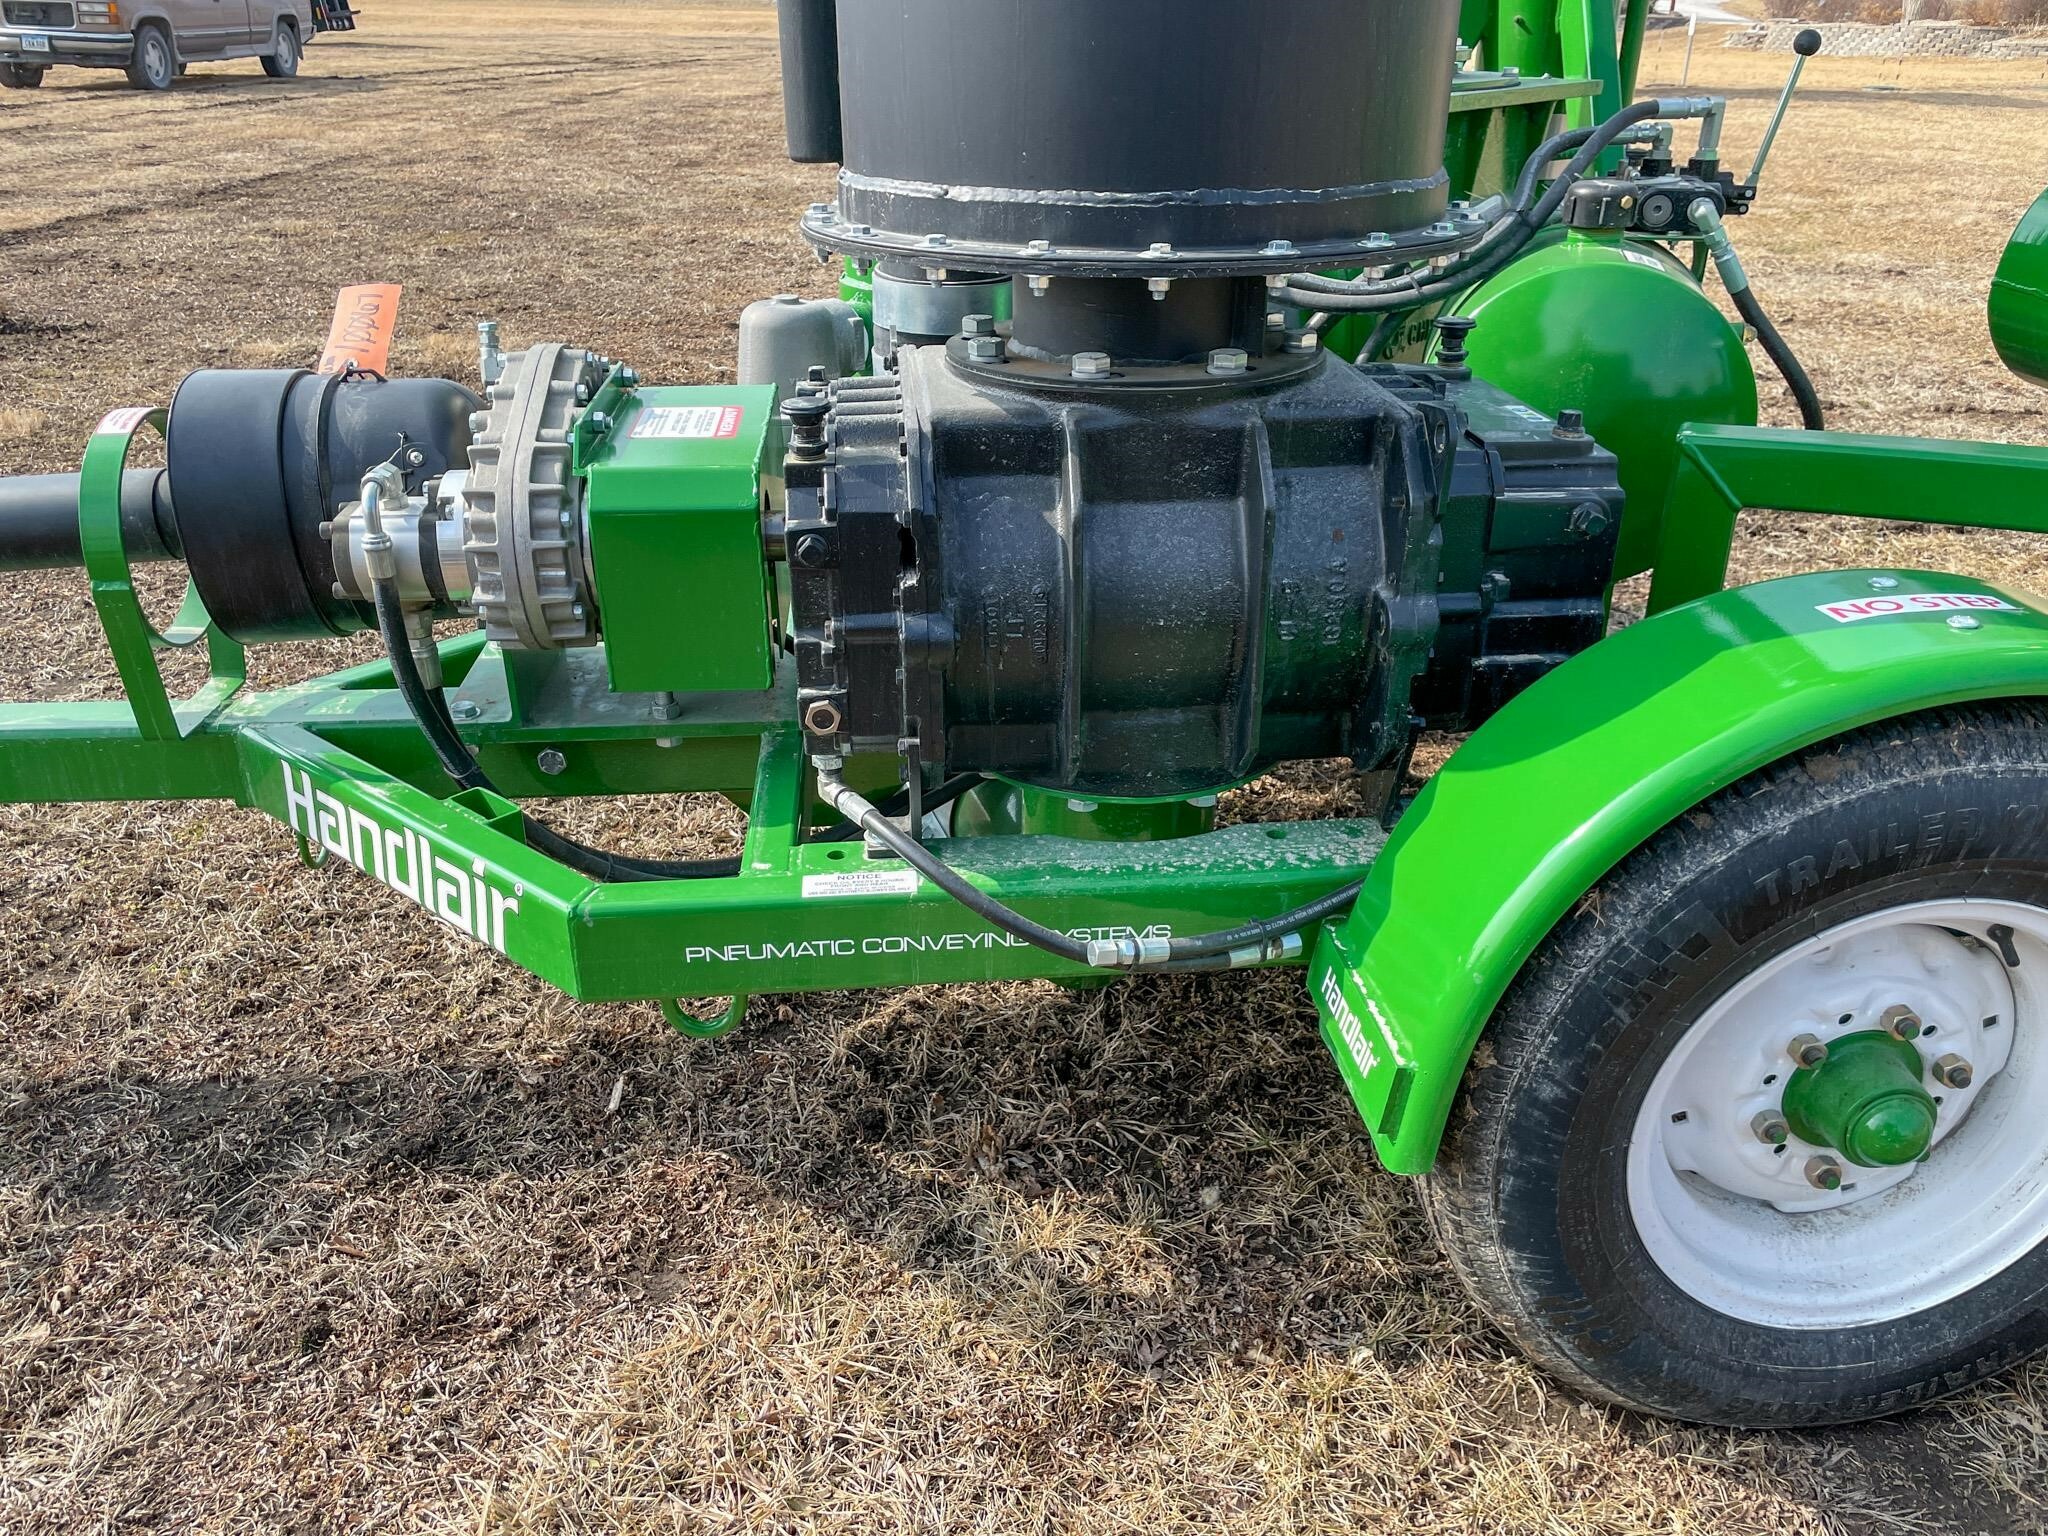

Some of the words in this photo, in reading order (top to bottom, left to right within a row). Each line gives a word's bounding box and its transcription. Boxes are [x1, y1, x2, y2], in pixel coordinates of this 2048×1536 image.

[1826, 600, 1904, 619] NO
[1909, 595, 2002, 608] STEP
[1753, 807, 1983, 906] TRAILER
[837, 873, 882, 881] NOTICE
[685, 940, 855, 963] PNEUMATIC
[1054, 925, 1172, 943] YSTEMS
[1321, 965, 1378, 1079] Handlair
